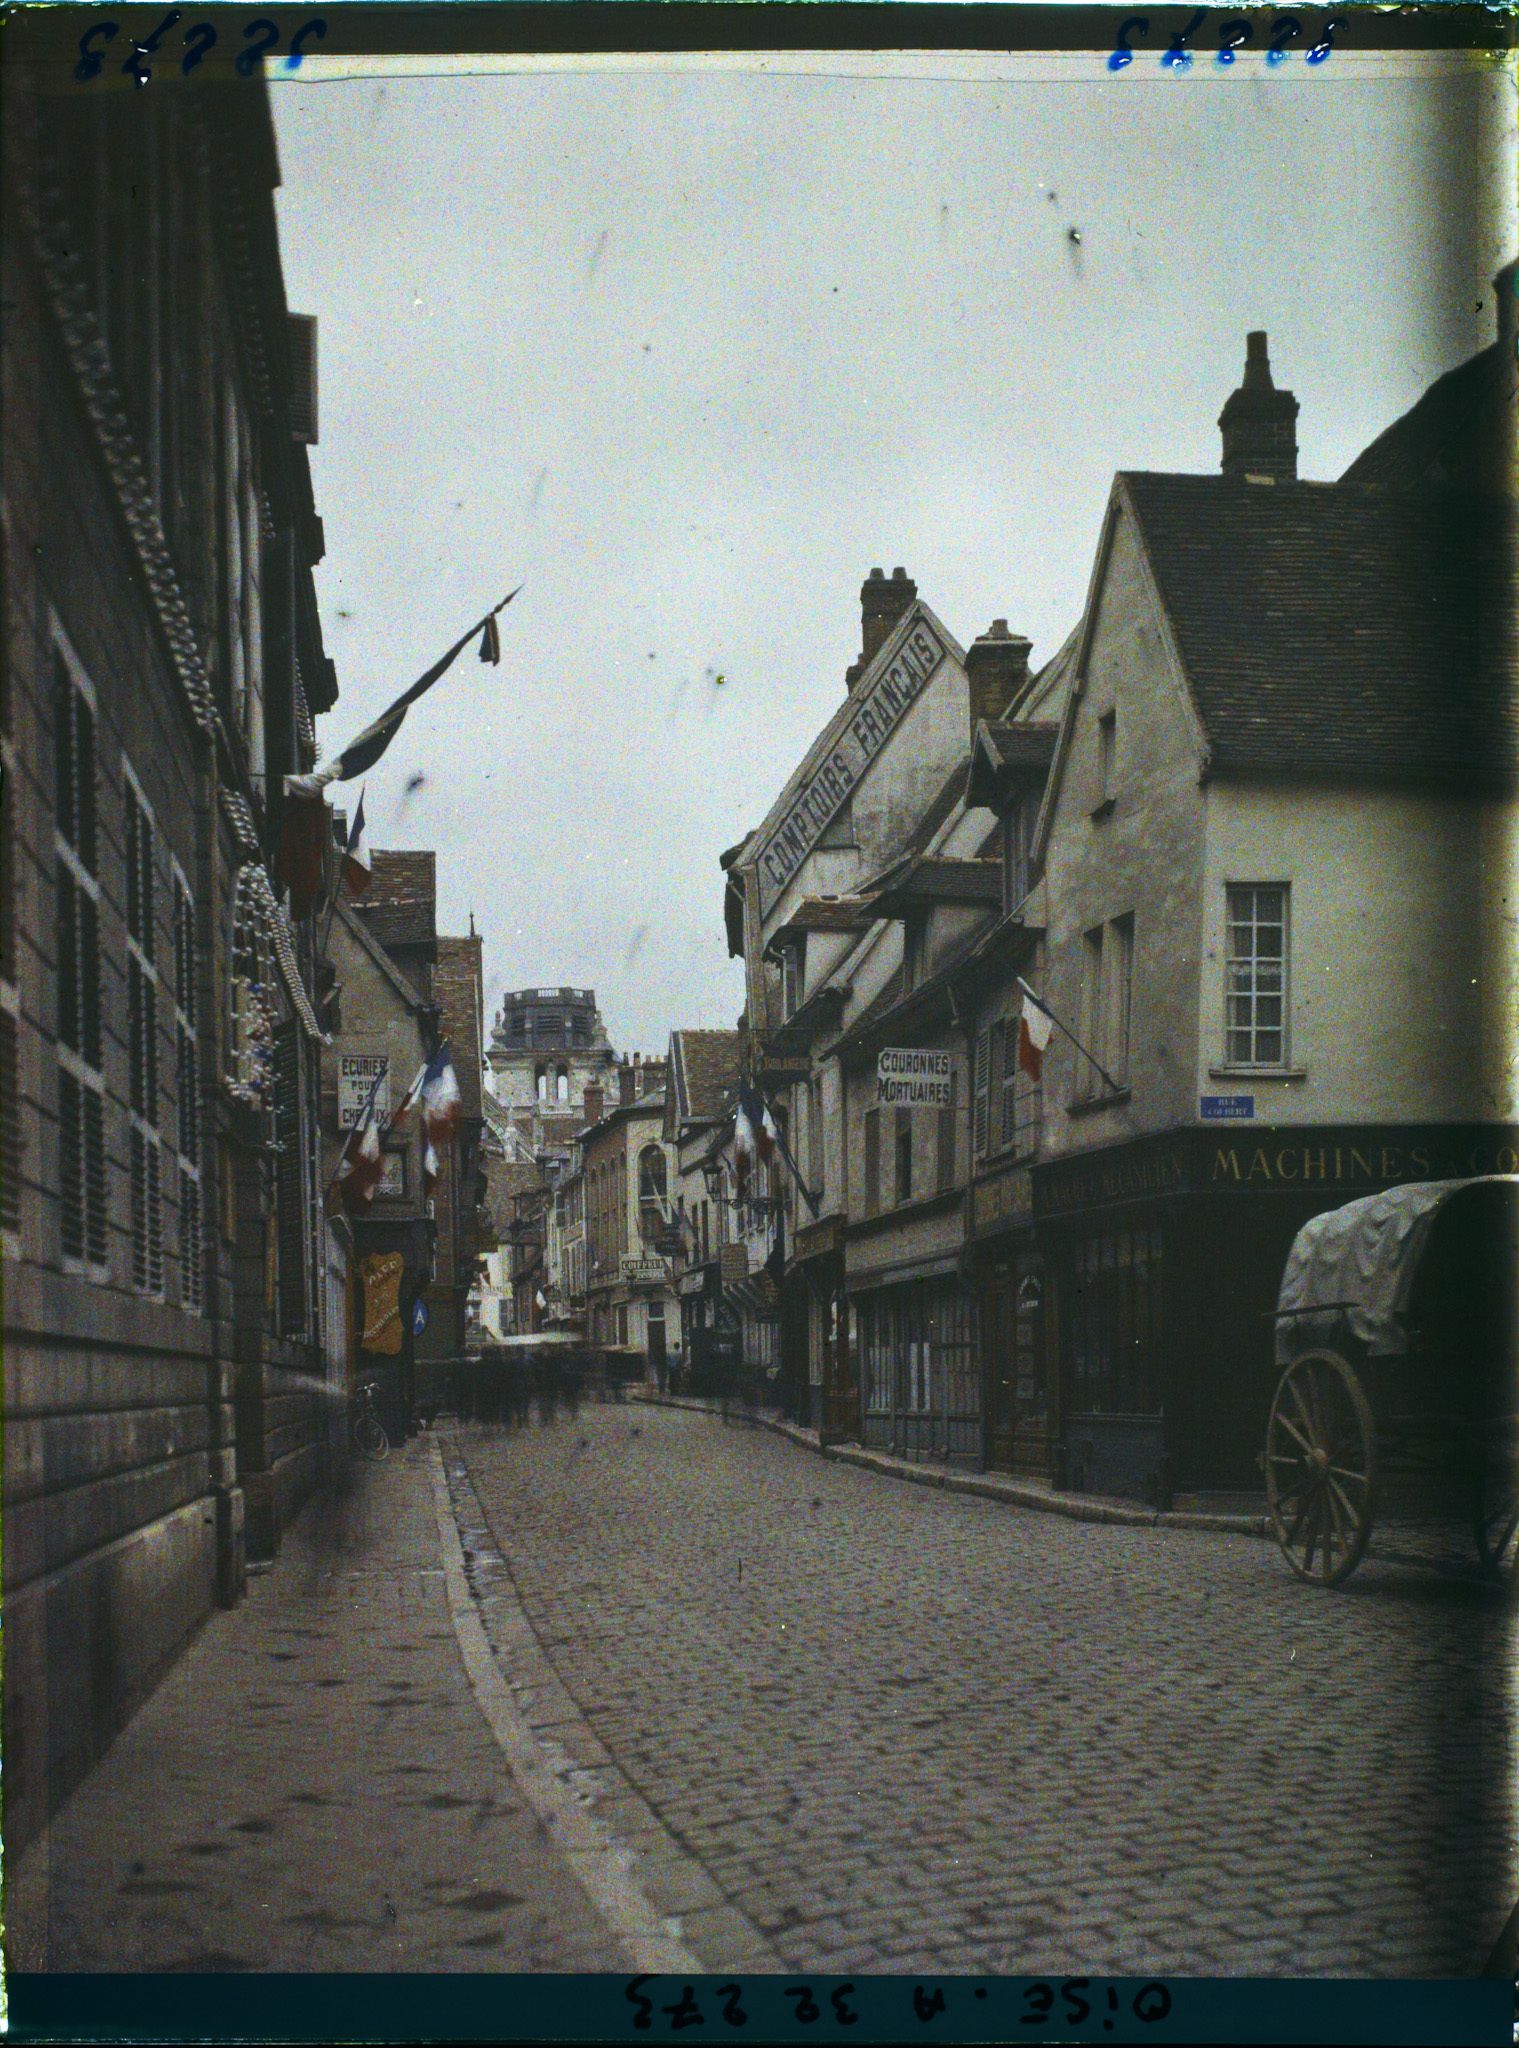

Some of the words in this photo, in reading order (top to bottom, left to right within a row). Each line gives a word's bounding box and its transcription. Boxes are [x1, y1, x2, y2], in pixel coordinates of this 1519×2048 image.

[764, 753, 855, 886] COMPTOIRS
[880, 1052, 949, 1075] COURONNES
[877, 1077, 950, 1103] MORTUAIRES
[1218, 1098, 1237, 1106] RUE
[1212, 1147, 1430, 1180] MACHINES
[415, 1307, 425, 1325] A
